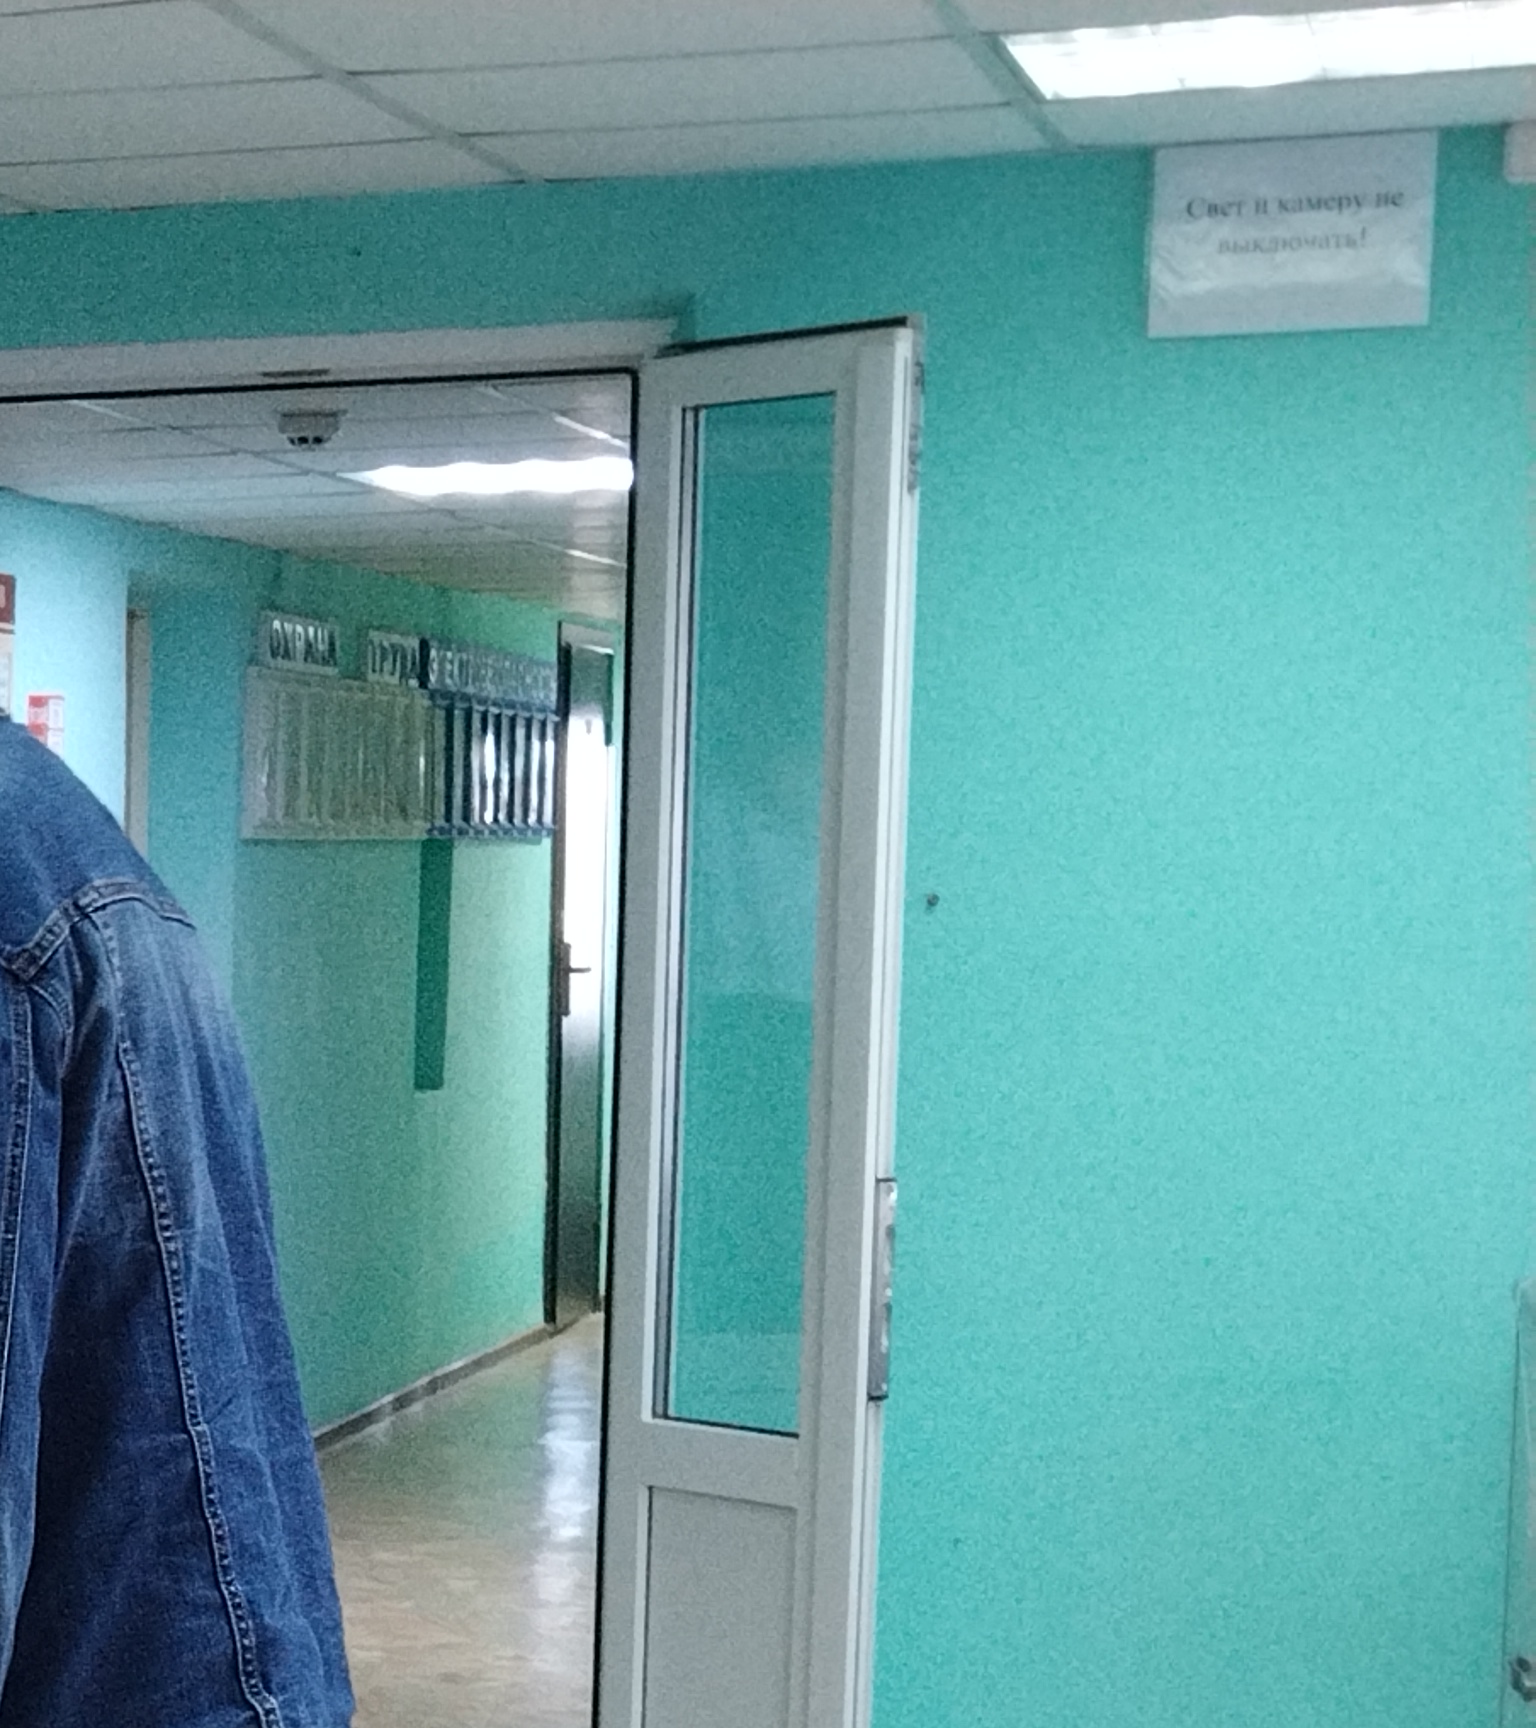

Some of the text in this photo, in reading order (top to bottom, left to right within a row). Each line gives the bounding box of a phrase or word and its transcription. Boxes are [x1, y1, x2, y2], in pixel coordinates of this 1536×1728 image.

[1186, 191, 1405, 219] Свет и камеру не
[1218, 226, 1367, 254] выключать!
